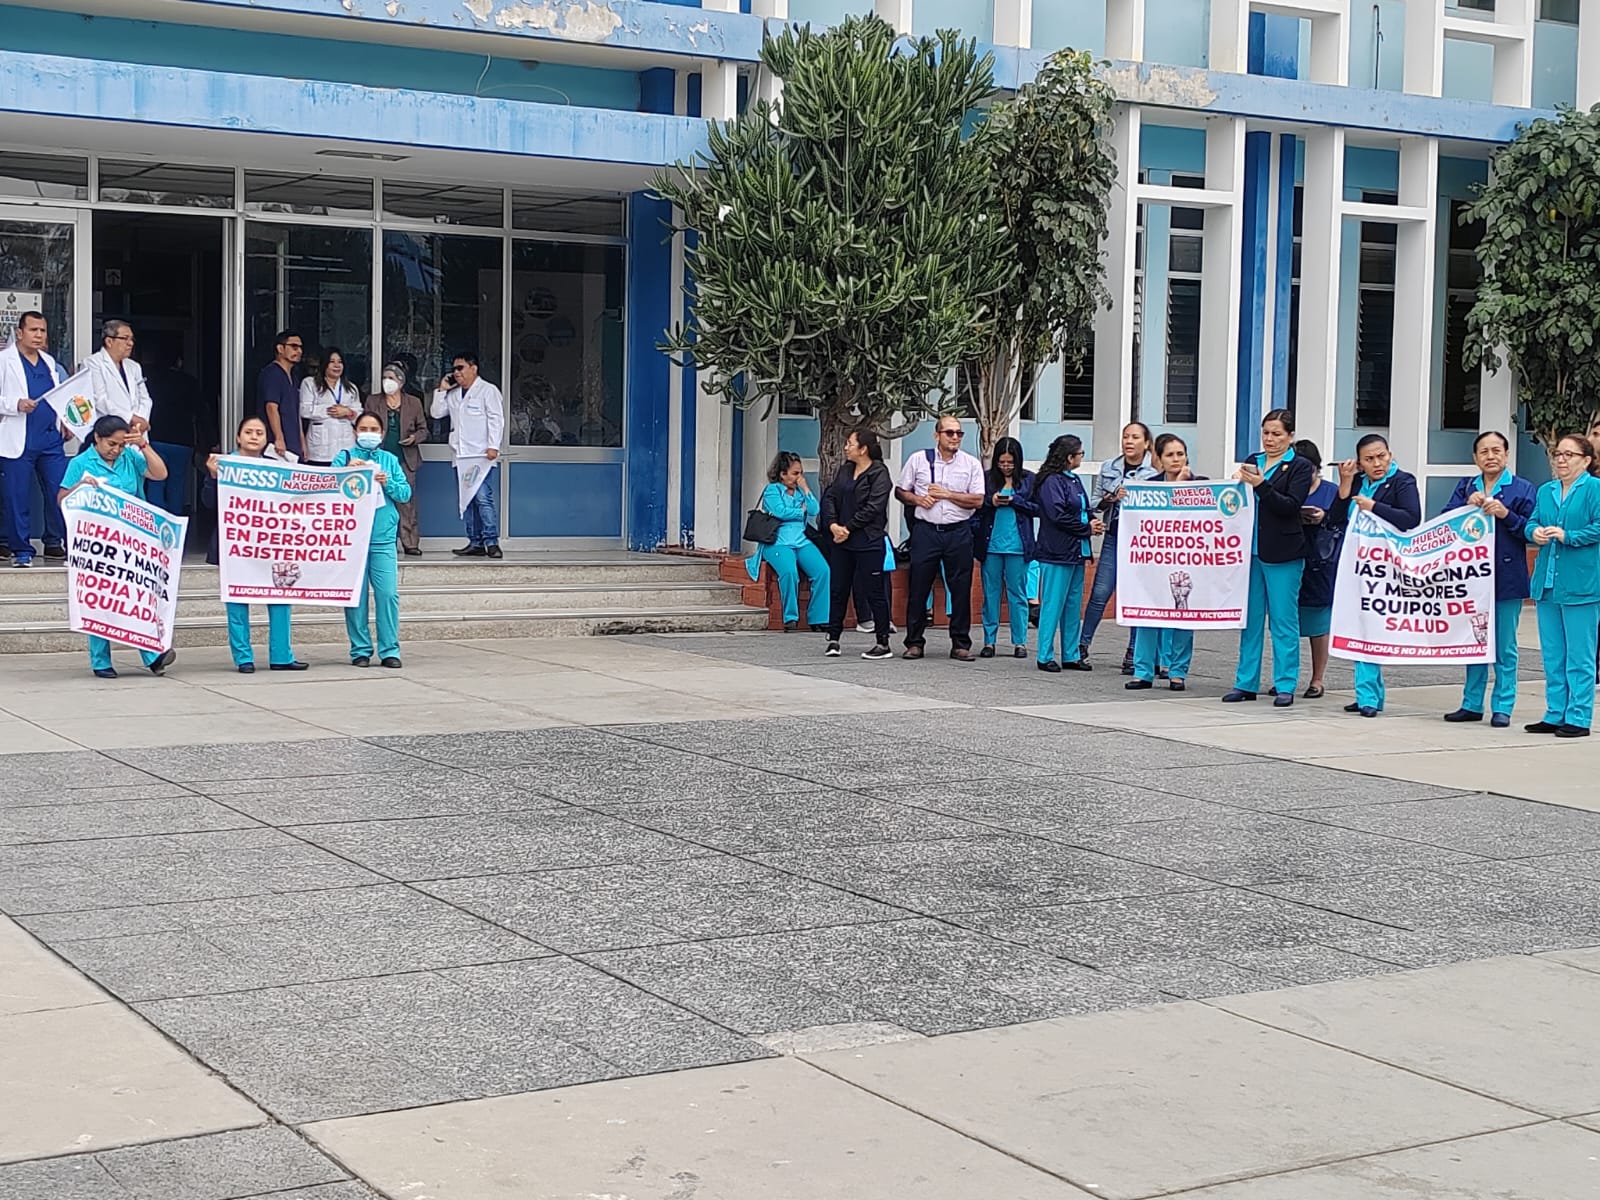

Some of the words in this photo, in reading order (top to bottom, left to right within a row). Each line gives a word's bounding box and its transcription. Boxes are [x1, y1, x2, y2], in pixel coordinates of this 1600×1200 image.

[284, 481, 338, 490] NACIONAL
[292, 473, 336, 482] HUELGA
[1123, 490, 1167, 506] SINESSS
[1174, 488, 1212, 496] HUELGA
[229, 496, 326, 516] ¡MILLONES
[332, 503, 354, 516] EN
[1172, 498, 1216, 506] NACIONAL
[126, 502, 154, 522] HUELGA
[121, 510, 159, 534] NACIONAL
[224, 512, 306, 532] ROBOTS,
[312, 518, 357, 532] CERO
[1140, 520, 1224, 534] ¡QUEREMOS
[226, 528, 250, 542] EN
[257, 532, 352, 546] PERSONAL
[1412, 525, 1450, 545] HUELGA
[77, 520, 147, 556] LUCHAMOS
[150, 547, 170, 568] POR
[1130, 536, 1210, 552] ACUERDOS,
[1214, 536, 1240, 549] NO
[229, 544, 346, 562] ASISTENCIAL
[1130, 551, 1243, 566] IMPOSICIONES!
[1444, 546, 1488, 564] POR
[123, 550, 132, 564] Y
[135, 555, 170, 585] MAYOR
[136, 588, 145, 602] Y
[1366, 581, 1379, 594] Y
[1385, 582, 1468, 599] MEJORES
[1361, 598, 1442, 616] EQUIPOS
[1447, 600, 1476, 616] DE
[92, 623, 106, 632] NO
[107, 626, 128, 638] HAY
[1386, 617, 1450, 634] SALUD
[1364, 644, 1399, 654] LUCHAS
[1417, 648, 1437, 656] HAY
